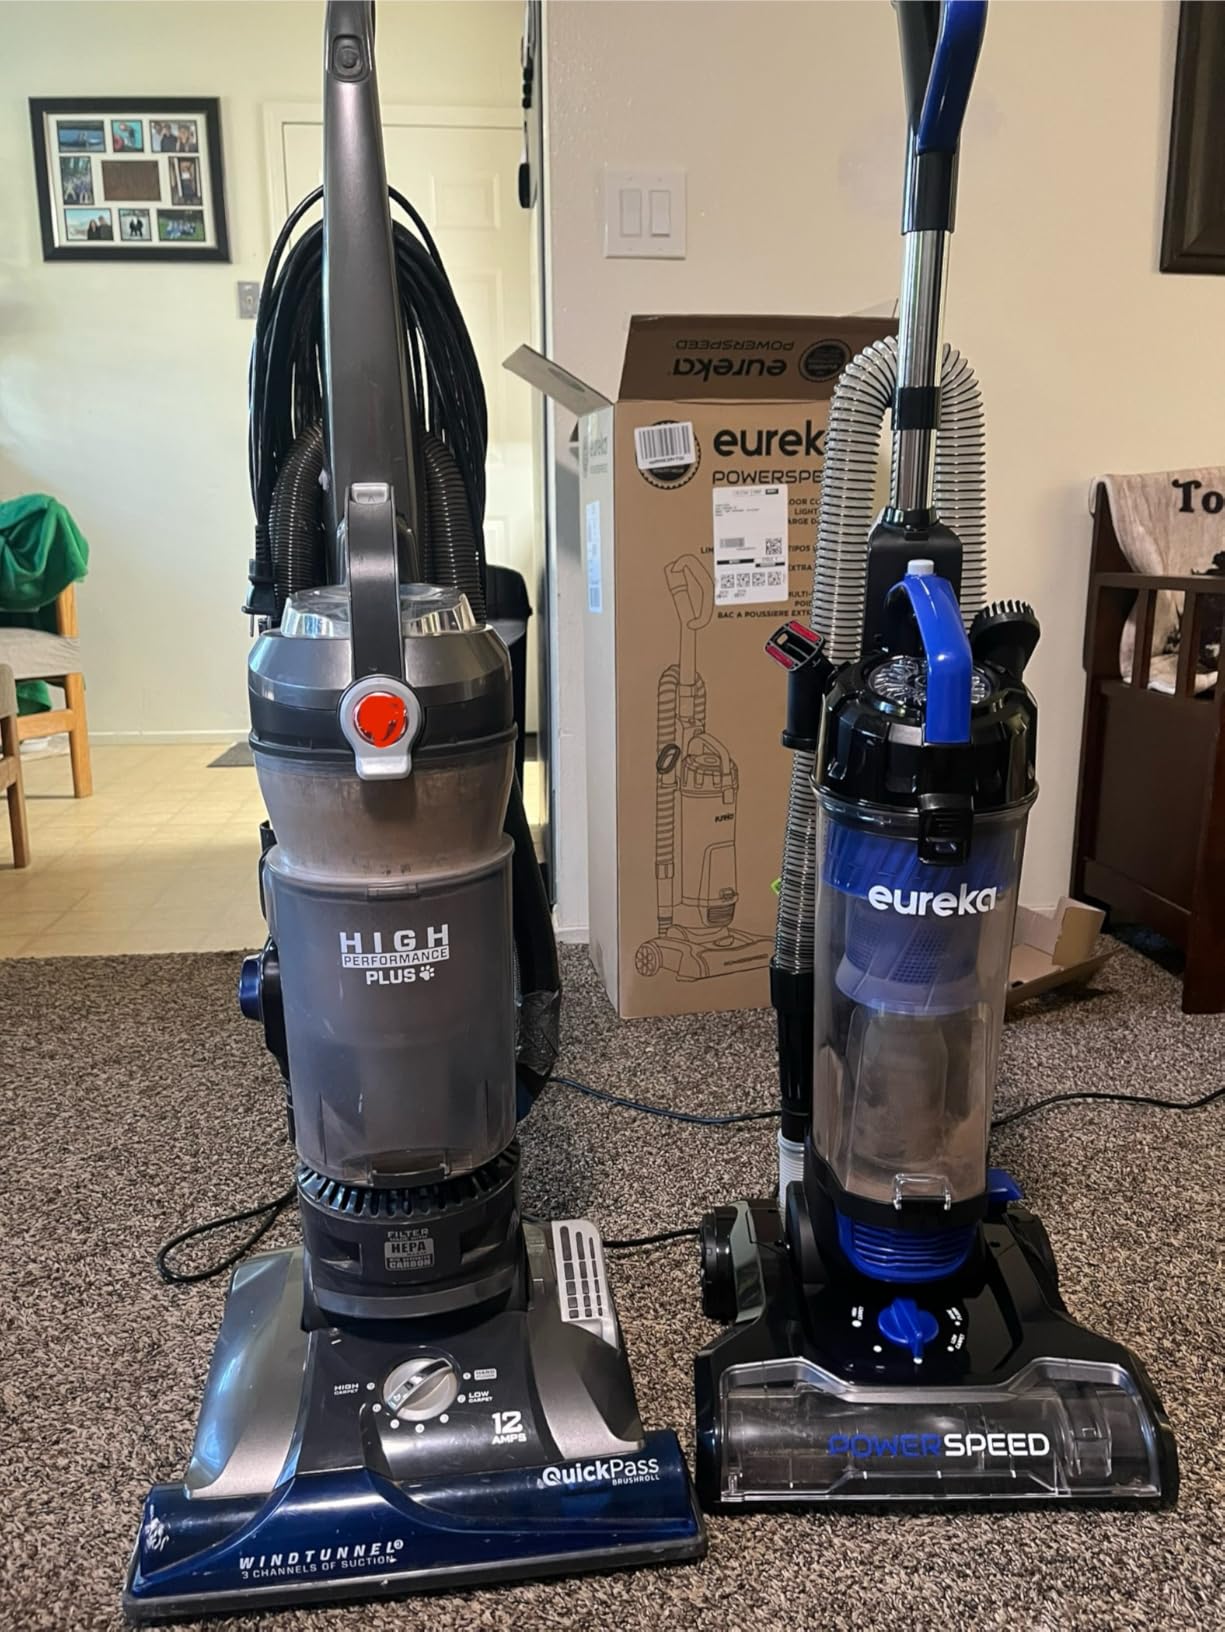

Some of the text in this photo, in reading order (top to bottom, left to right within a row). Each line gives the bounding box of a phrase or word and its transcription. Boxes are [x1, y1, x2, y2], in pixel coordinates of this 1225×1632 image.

[676, 339, 795, 351] POWERSPEED
[673, 358, 787, 382] eureka
[713, 420, 829, 457] eurek
[712, 470, 824, 485] POWERSPE
[744, 610, 789, 618] POUSSIERE
[868, 883, 997, 917] eureka
[339, 923, 449, 953] HIGH
[343, 947, 448, 966] PERFORMANCE
[366, 968, 416, 985] PLUS
[387, 1228, 430, 1238] FILTER
[391, 1241, 427, 1253] HEPA
[334, 1383, 359, 1391] HIGH
[469, 1390, 489, 1399] LOW
[491, 1411, 524, 1434] 12
[491, 1433, 527, 1445] AMPS
[828, 1433, 1050, 1458] POWERSPEED
[542, 1459, 660, 1486] QuickPass
[612, 1474, 660, 1486] BRUSHROLL
[239, 1541, 395, 1570] WINDTUNNEL
[242, 1554, 393, 1579] 3 CHANNELS OF SUCTION
